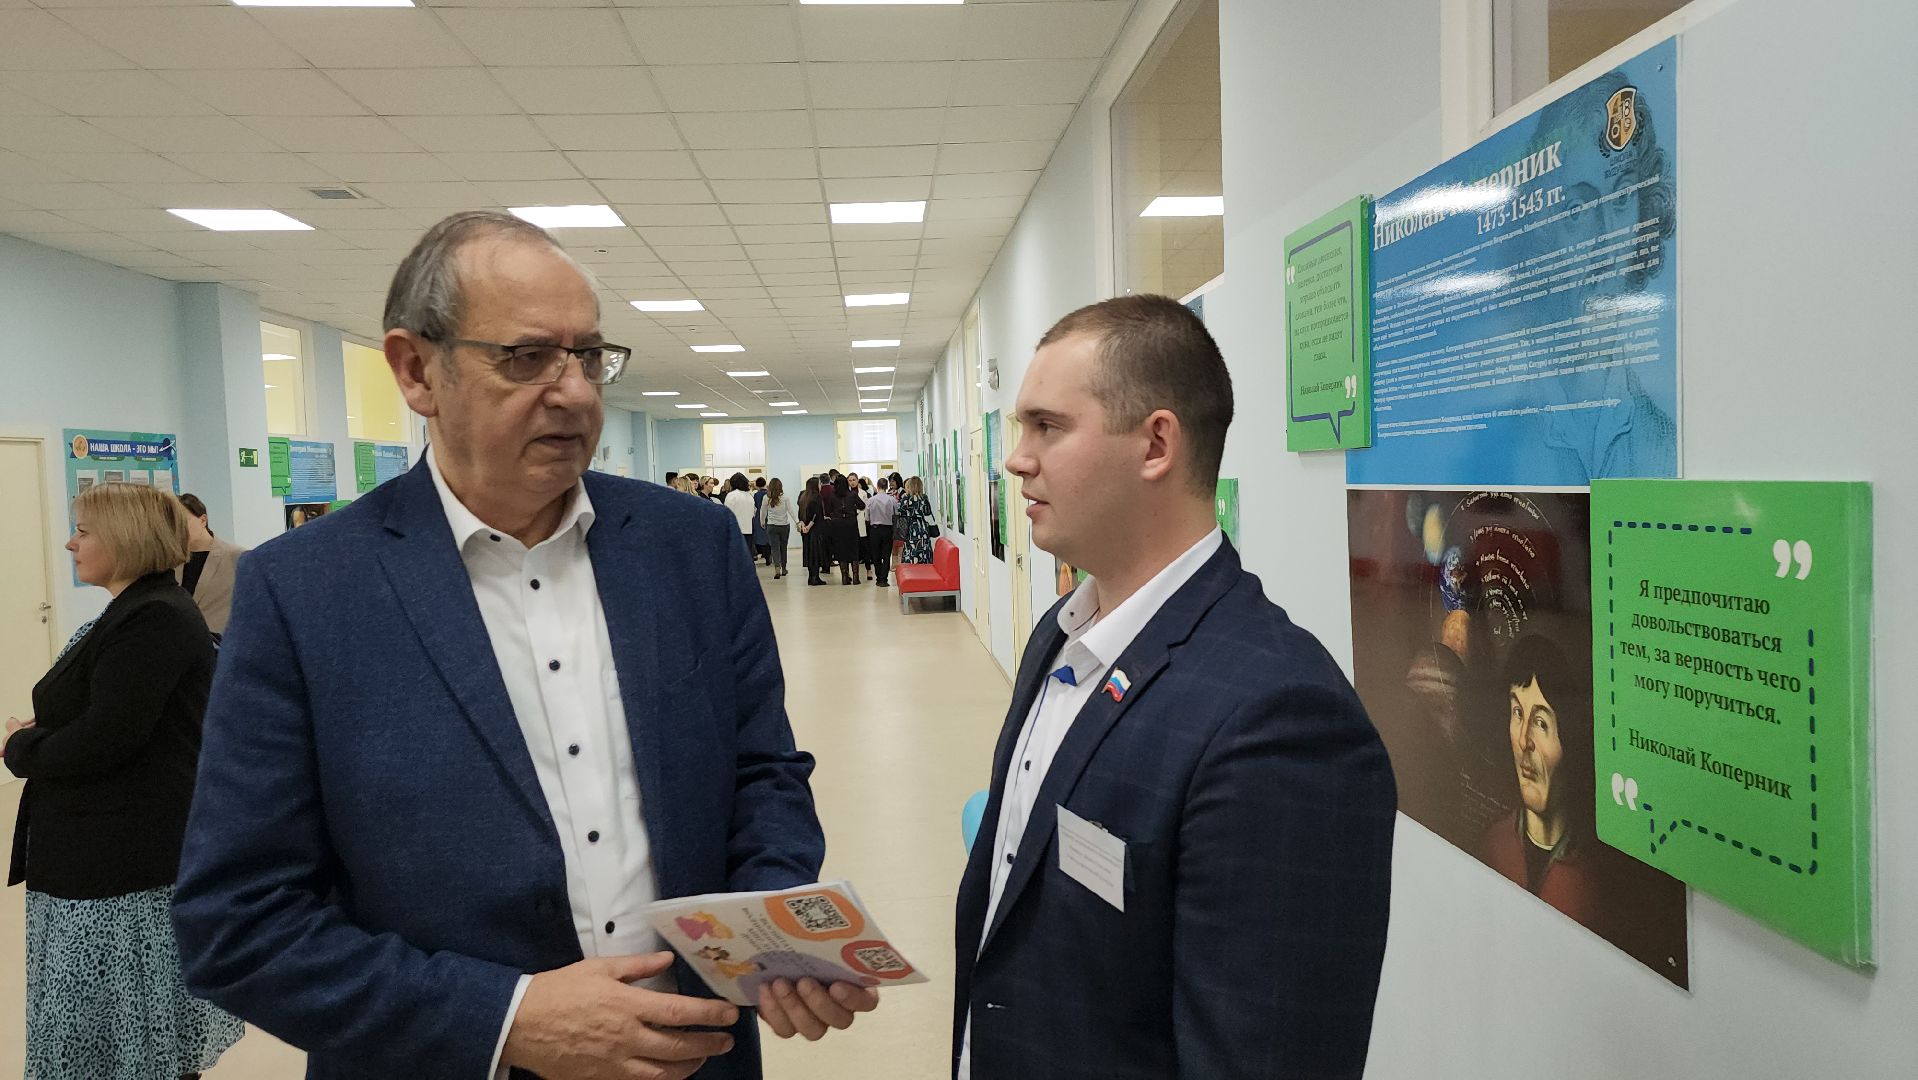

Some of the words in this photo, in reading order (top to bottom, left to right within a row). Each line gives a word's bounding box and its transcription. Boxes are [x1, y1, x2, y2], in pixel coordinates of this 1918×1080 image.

[1476, 187, 1544, 236] 1473-1543
[1546, 186, 1567, 208] гг.
[90, 442, 109, 452] НАША
[110, 443, 131, 453] ШКОЛА
[136, 444, 146, 454] ЭТО
[147, 445, 159, 454] МЫ!
[1639, 579, 1650, 598] Я
[1653, 585, 1770, 615] предпочитаю
[1631, 613, 1782, 653] довольствоваться
[1620, 641, 1650, 664] тем,
[1654, 647, 1671, 664] за
[1675, 652, 1754, 682] верность
[1757, 669, 1801, 693] чего
[1634, 674, 1670, 699] могу
[1674, 683, 1782, 725] поручиться.
[1628, 727, 1696, 767] Николай
[1700, 750, 1792, 800] Коперник
